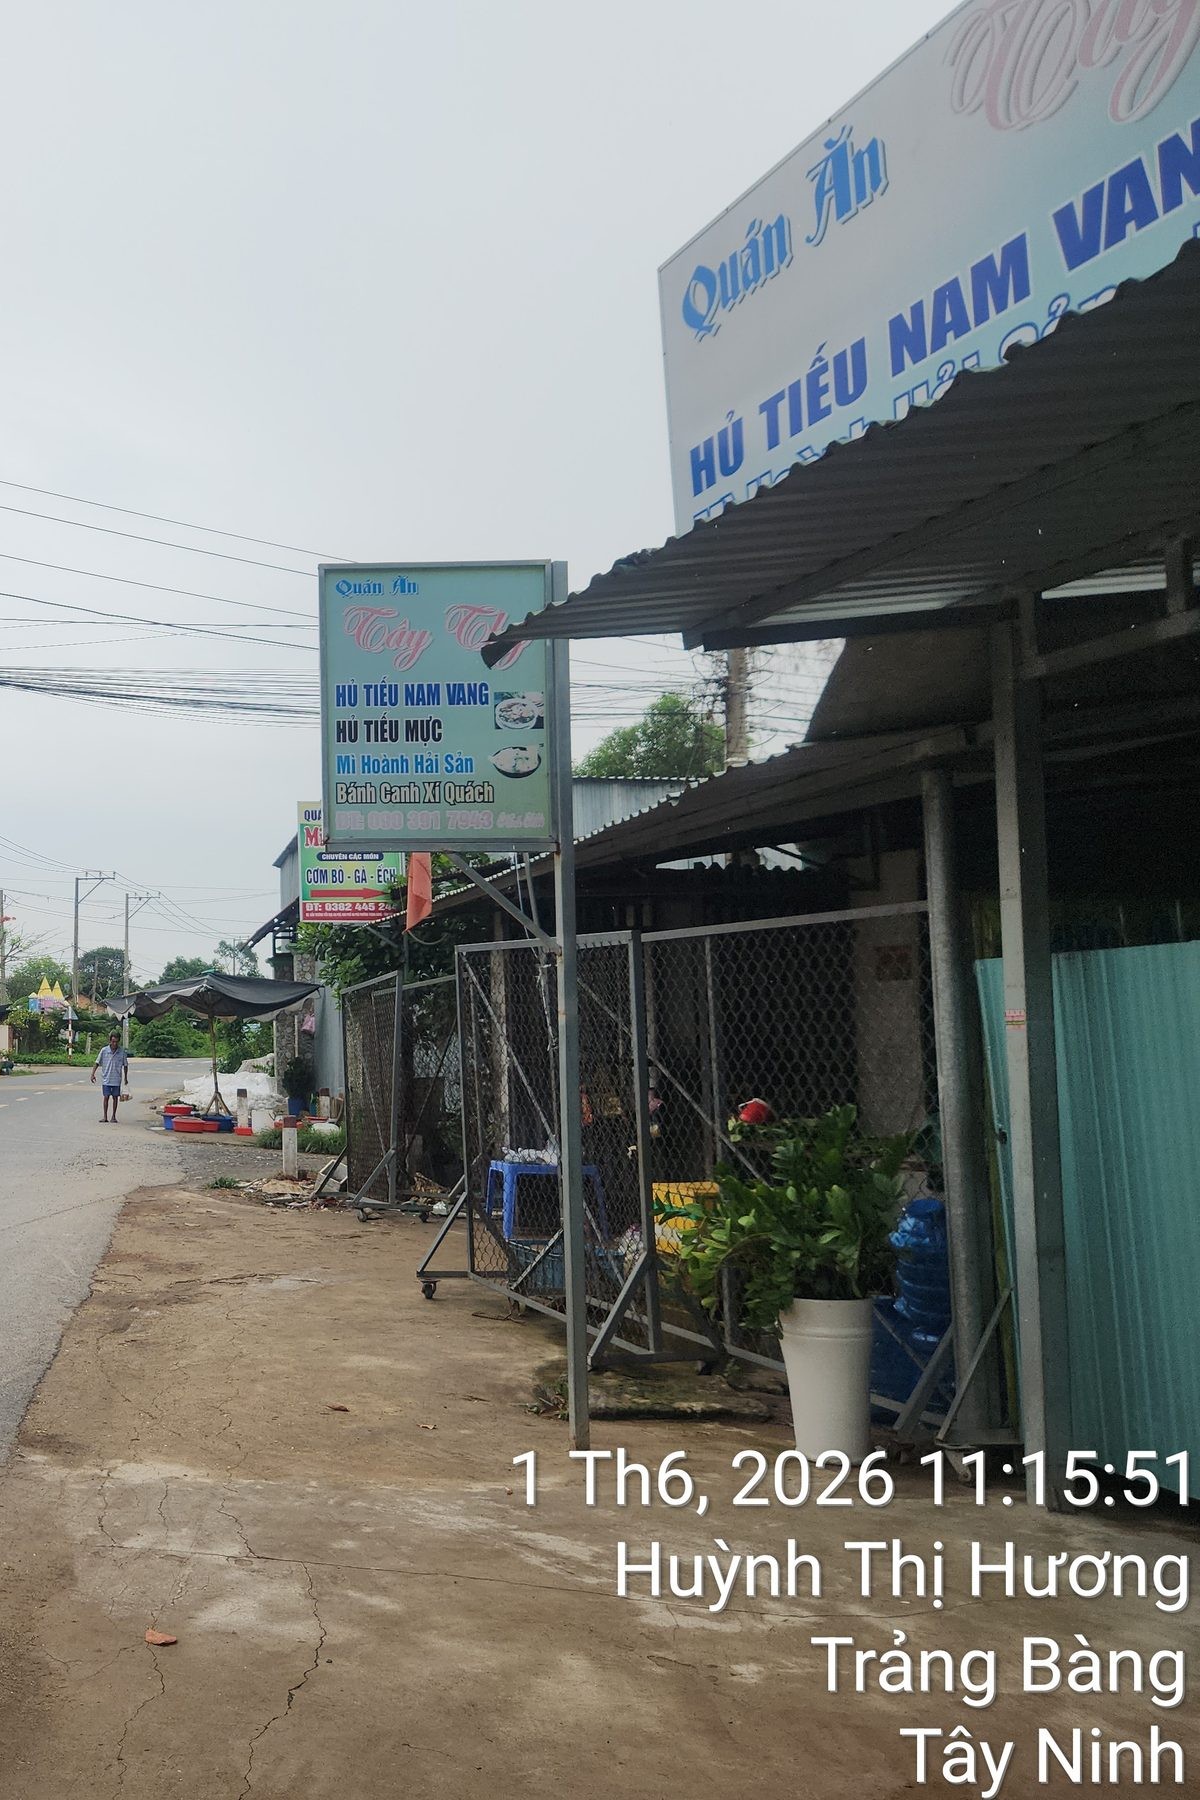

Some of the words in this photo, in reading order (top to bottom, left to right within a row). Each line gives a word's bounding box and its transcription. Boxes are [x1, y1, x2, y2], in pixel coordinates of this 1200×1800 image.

[681, 214, 793, 341] Quán
[805, 124, 889, 246] Ăn
[689, 409, 744, 498] HỦ
[759, 340, 869, 451] TIẾU
[888, 232, 1031, 377] NAM
[335, 578, 384, 598] Quán
[390, 575, 419, 595] Ăn
[336, 679, 358, 708] HỦ
[364, 676, 399, 707] TIẾU
[405, 683, 441, 706] NAM
[446, 682, 490, 706] VANG
[336, 714, 358, 743] HỦ
[364, 712, 400, 743] TIẾU
[405, 716, 443, 747] MỰC
[337, 754, 356, 774] Mì
[361, 754, 409, 774] Hoành
[414, 752, 439, 774] Hải
[444, 752, 474, 774] Sản
[336, 782, 377, 804] Bánh
[380, 781, 420, 804] Canh
[422, 780, 442, 804] Xí
[444, 780, 495, 805] Quách
[306, 867, 328, 884] CƠM
[331, 865, 345, 884] BÒ
[354, 865, 368, 884] GÀ
[355, 902, 376, 911] 445
